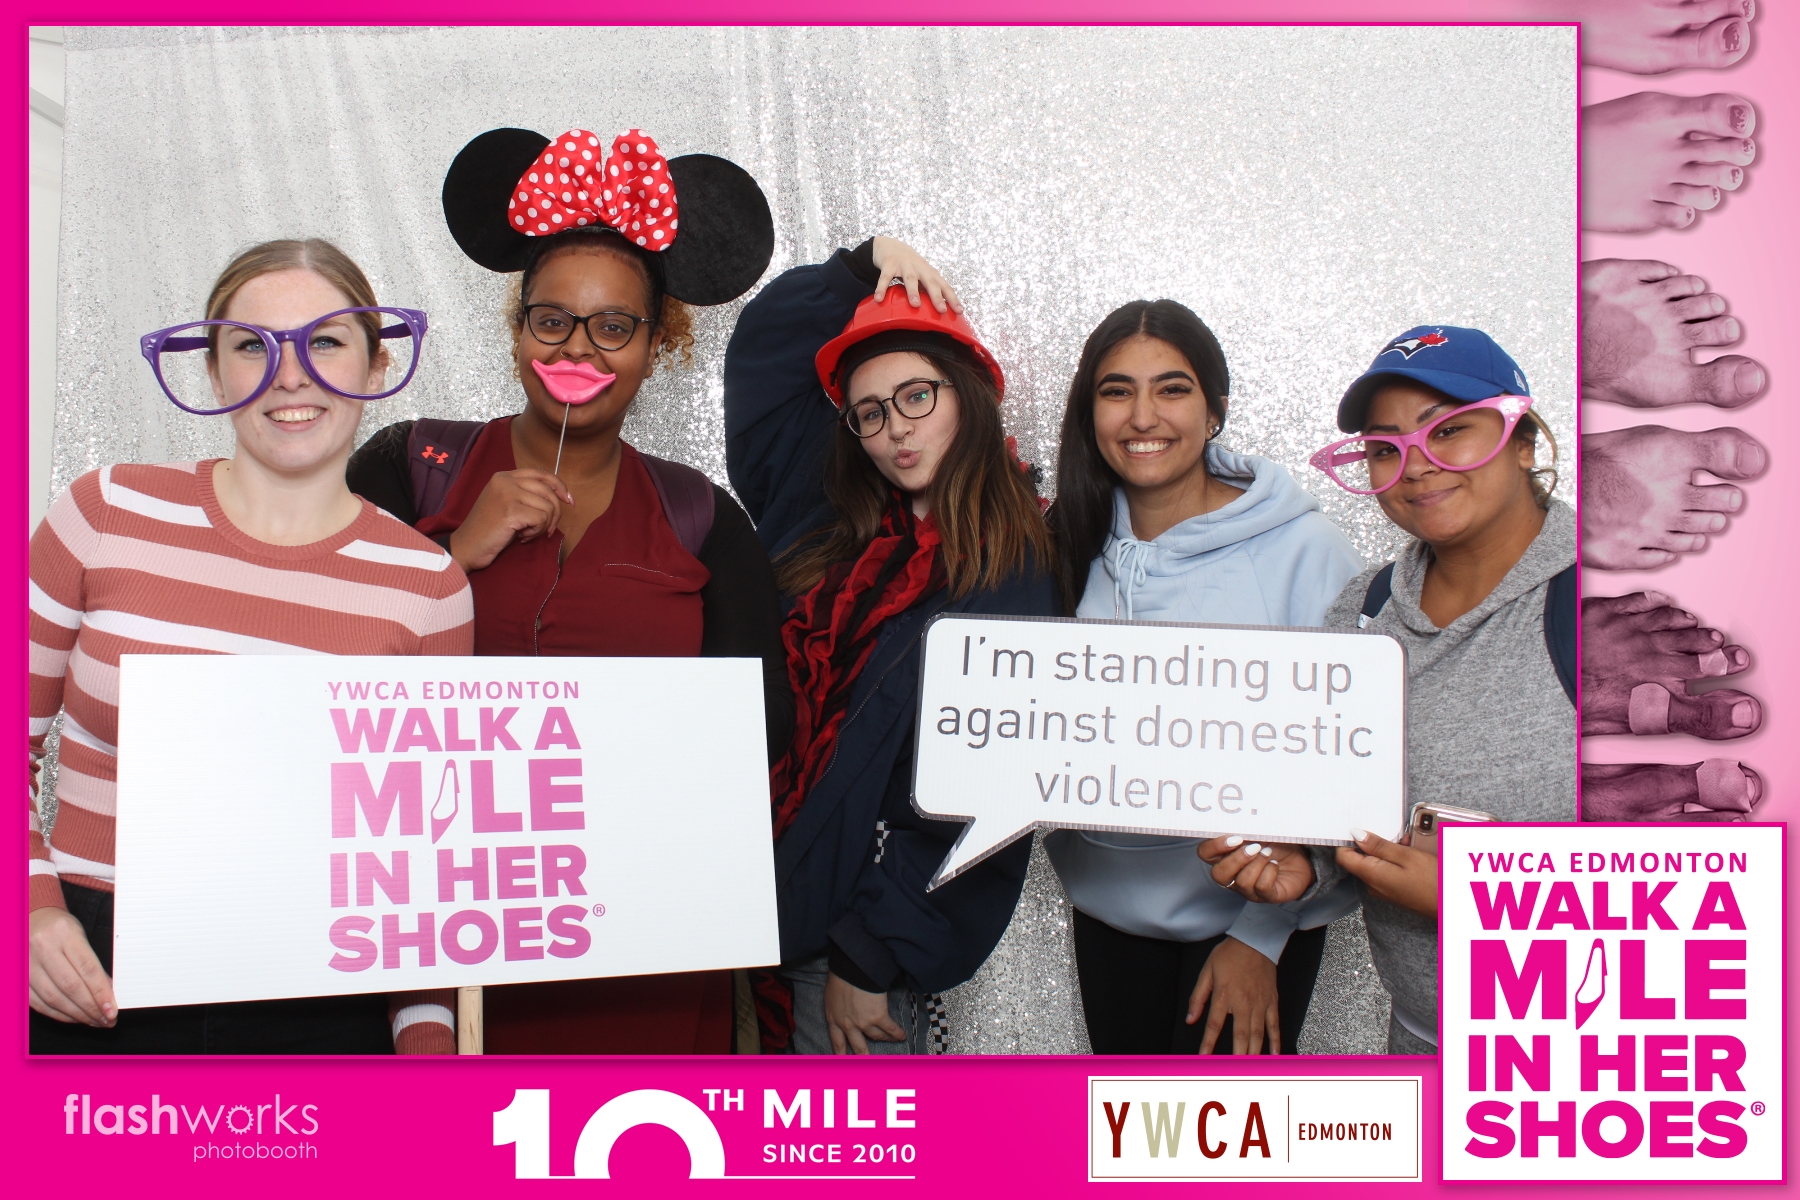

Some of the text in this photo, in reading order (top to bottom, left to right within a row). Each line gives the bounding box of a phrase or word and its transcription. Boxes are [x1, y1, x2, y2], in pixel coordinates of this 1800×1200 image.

[327, 681, 580, 700] YWCA EDMONTON
[1053, 644, 1270, 702] standing
[1292, 661, 1353, 705] up
[328, 706, 582, 753] WALK A
[936, 698, 1374, 758] against domestic
[1034, 762, 1259, 816] violence.
[329, 844, 589, 908] IN HER
